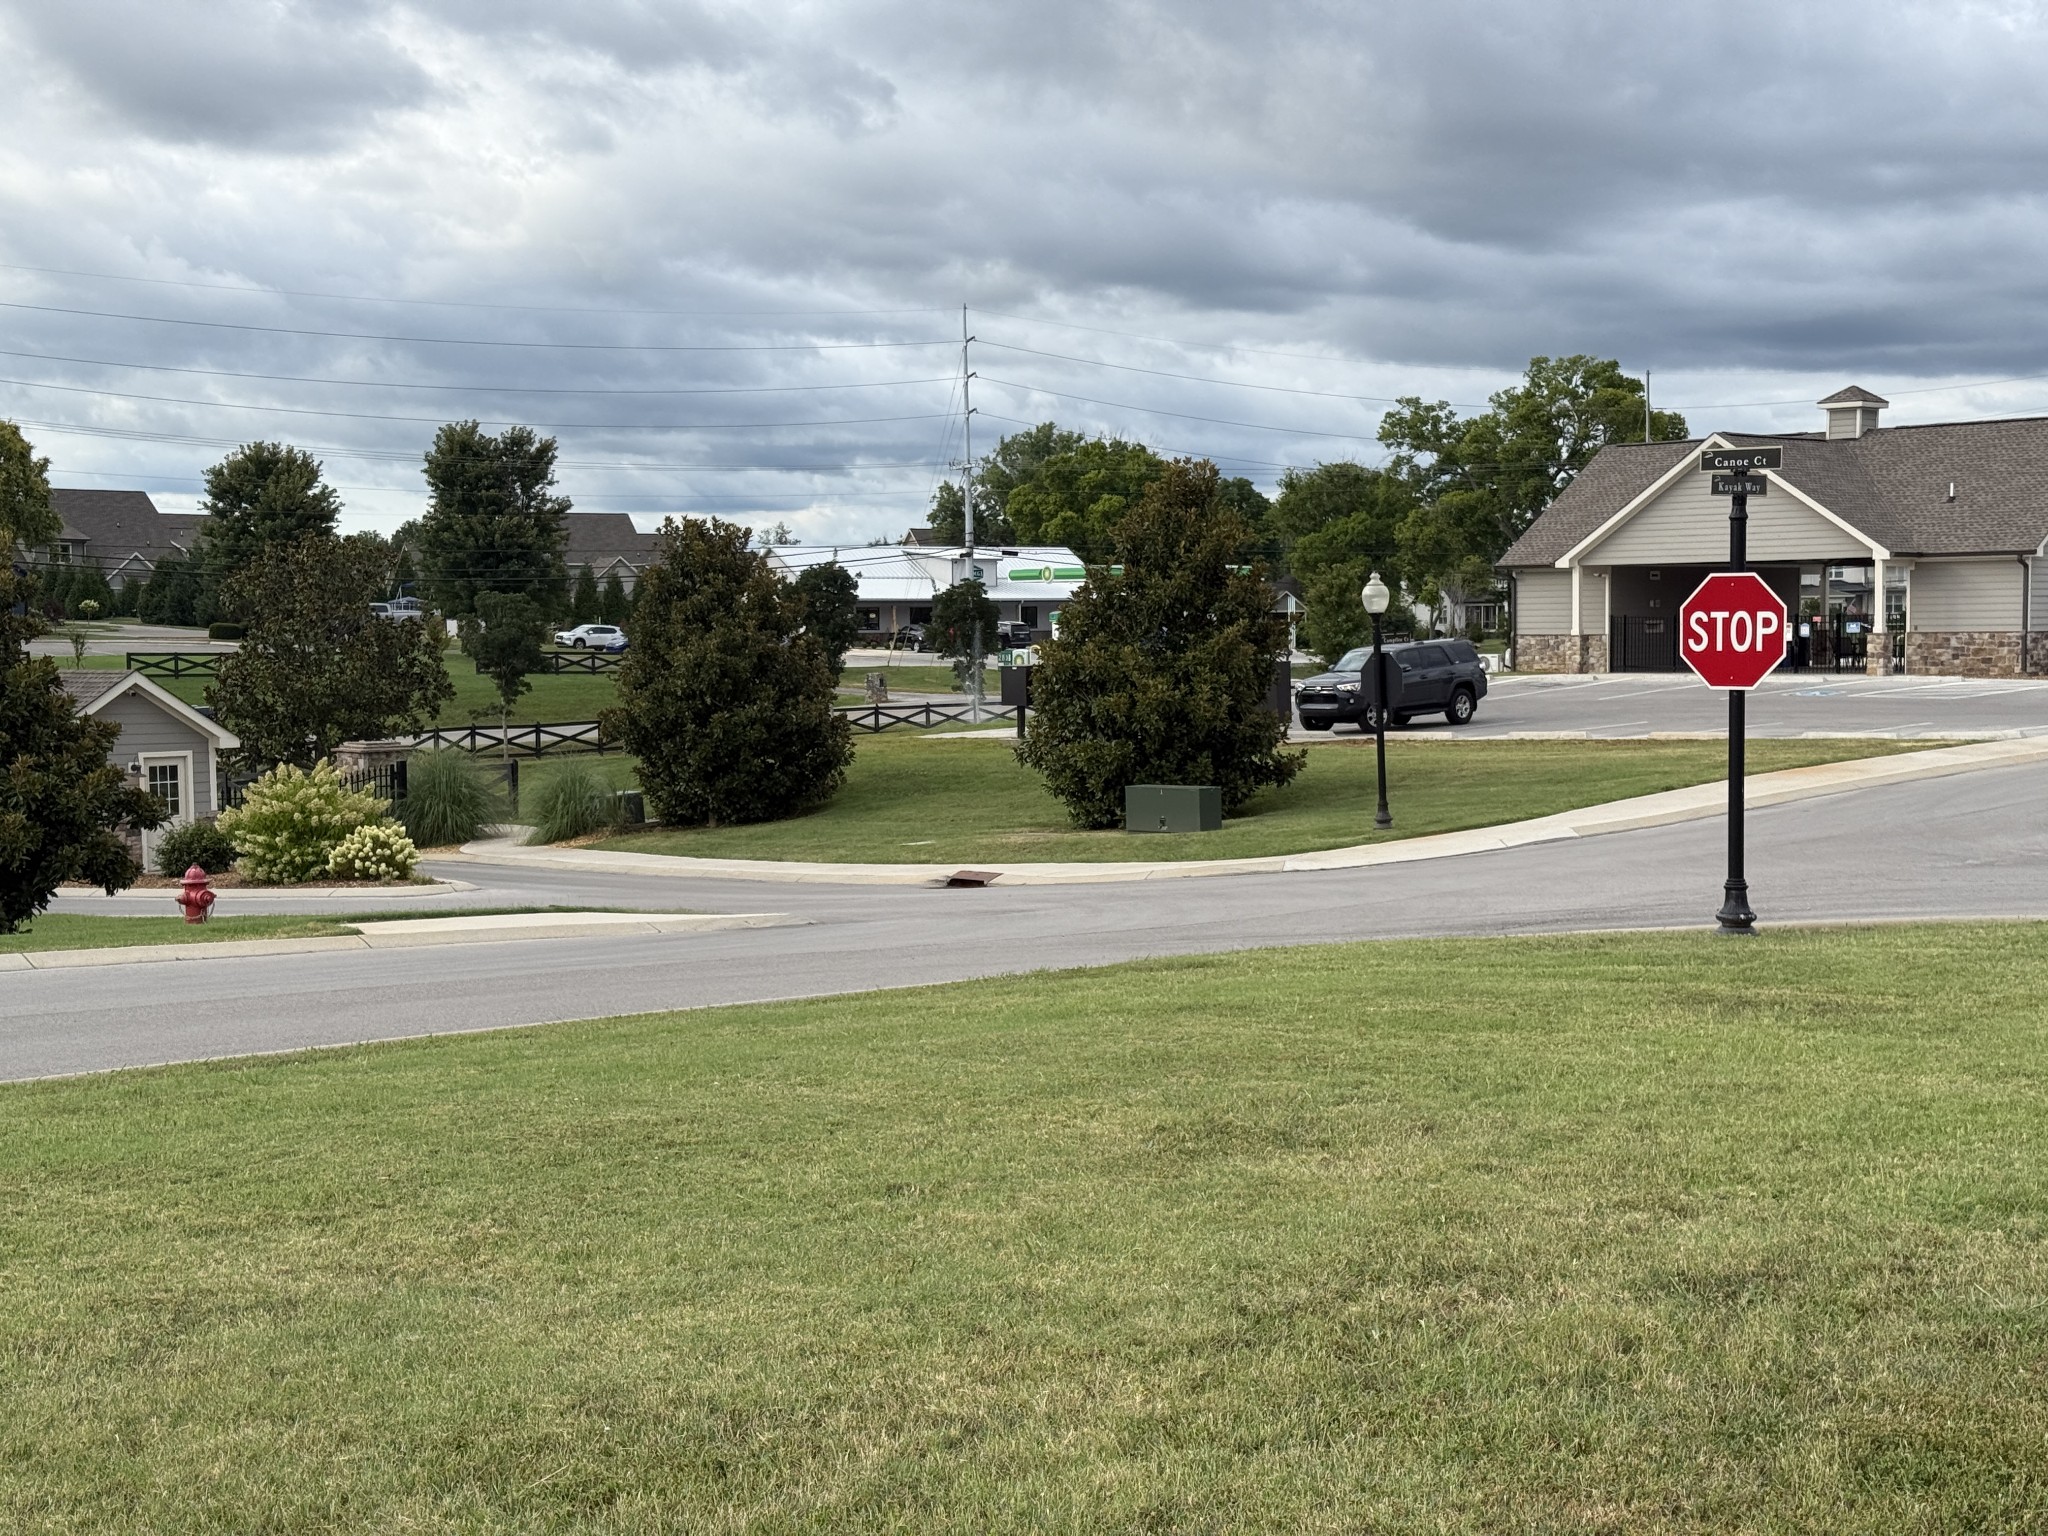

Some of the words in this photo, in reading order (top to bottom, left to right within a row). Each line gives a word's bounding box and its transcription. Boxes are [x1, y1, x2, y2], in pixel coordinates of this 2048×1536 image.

[1714, 457, 1749, 467] Canoe
[1754, 456, 1767, 466] Ct
[1718, 482, 1742, 493] Kayak
[1745, 482, 1761, 493] Way
[1688, 610, 1778, 652] STOP
